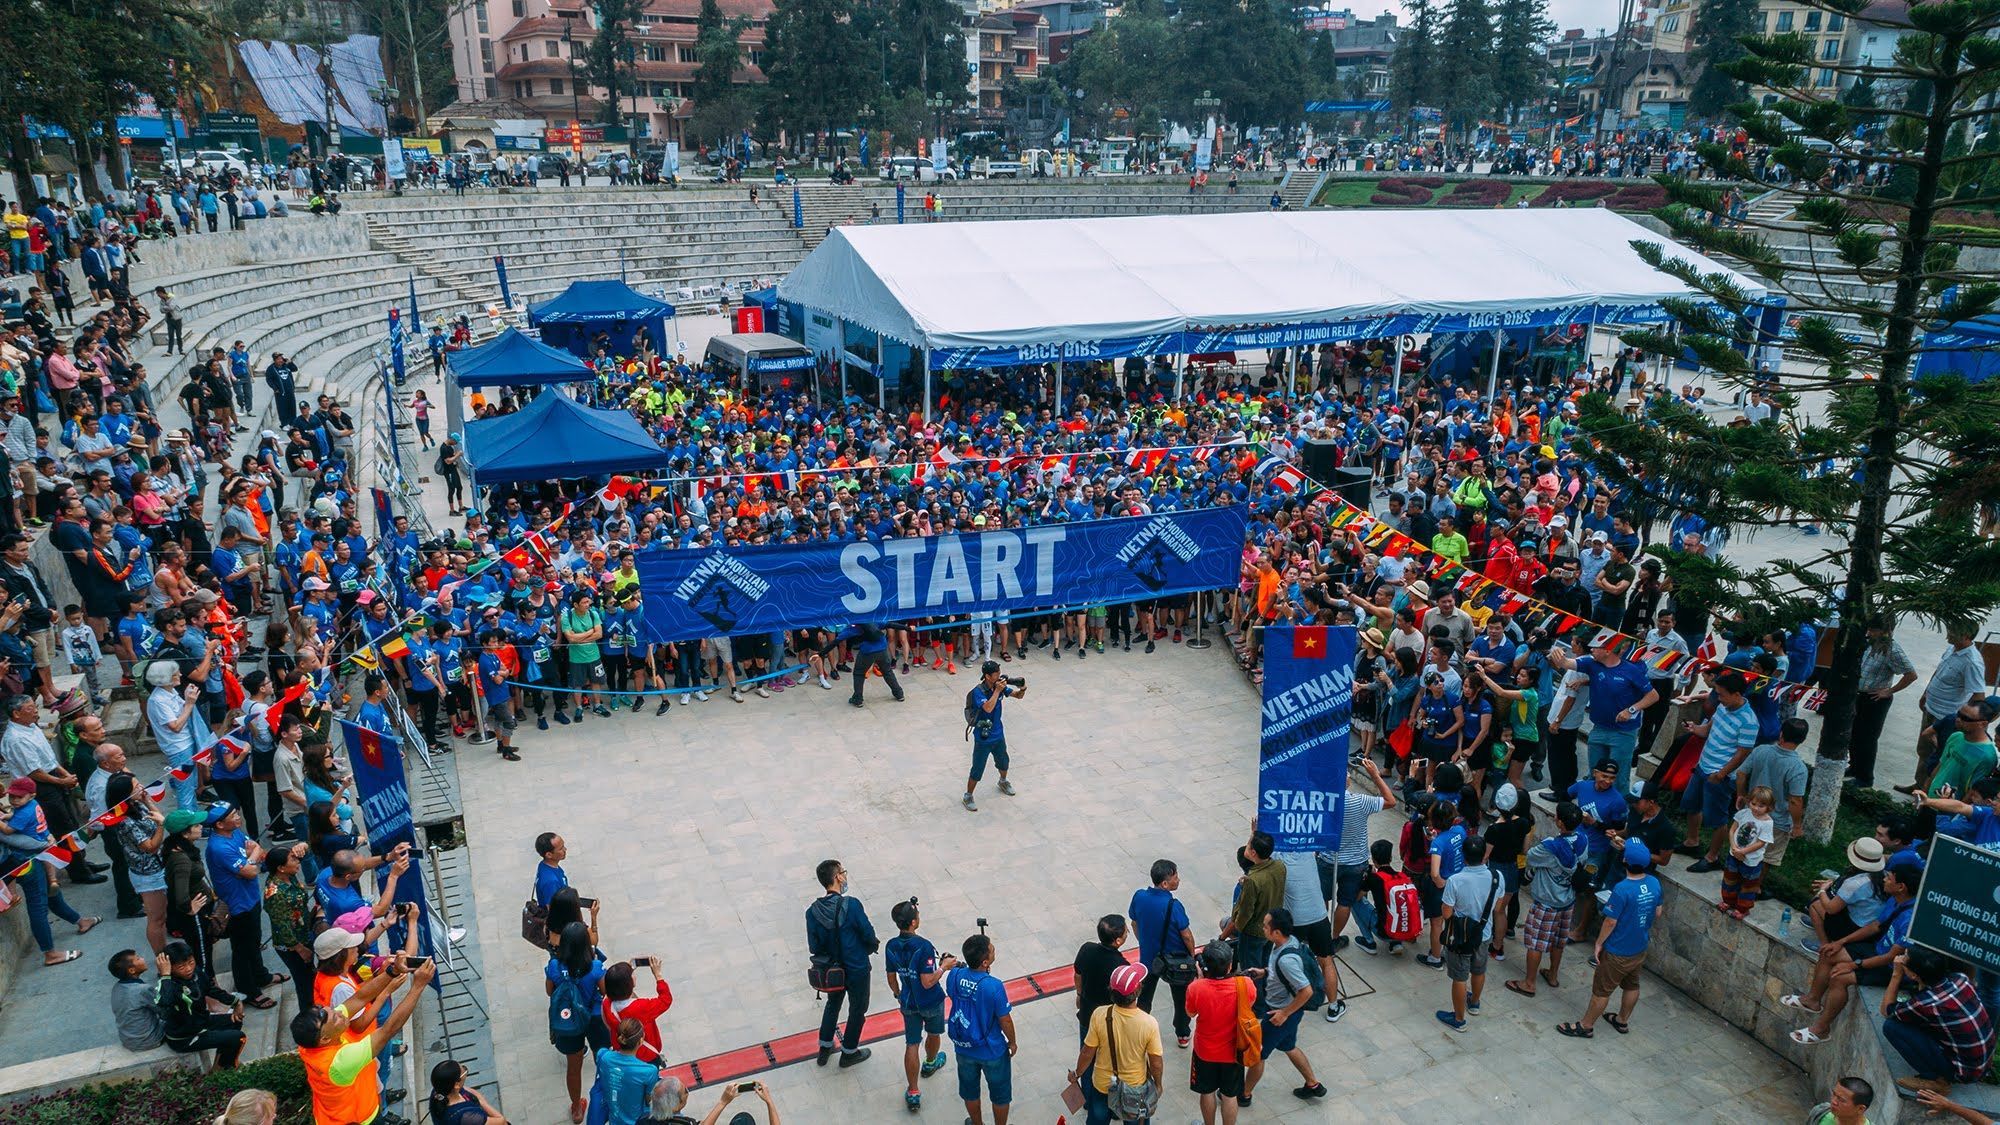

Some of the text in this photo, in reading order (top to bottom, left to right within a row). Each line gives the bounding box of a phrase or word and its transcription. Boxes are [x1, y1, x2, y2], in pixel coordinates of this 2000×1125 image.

[1234, 324, 1357, 346] VMM SHOP AND HANOI RELAY
[1468, 310, 1532, 328] RACE BIBS
[757, 358, 787, 371] LUGGAGE
[786, 357, 806, 369] DROP
[1018, 340, 1101, 361] RACE BIBS
[1115, 514, 1172, 564] VIETNAM
[1157, 528, 1195, 563] MARATHON
[1164, 521, 1202, 556] MOUNTAIN
[716, 564, 763, 602] MARATHON
[723, 555, 771, 594] MOUNTAIN
[839, 525, 1066, 614] START
[1261, 663, 1354, 723] VIETNAM
[1261, 688, 1353, 739] MOUNTAIN MARATHON
[1267, 752, 1289, 768] TRAILS
[1287, 740, 1312, 759] BEATEN
[1309, 735, 1320, 748] BY
[1318, 723, 1351, 744] BUFFALOES
[1263, 789, 1340, 812] START
[1277, 813, 1324, 834] 10KM
[1971, 852, 1994, 866] BAN
[1400, 902, 1409, 932] VICTOR
[1927, 890, 1999, 929] CHƠI BÓNG ĐÁ,
[1940, 914, 1974, 936] TRƯỢT
[1949, 936, 2000, 966] TRONG KH
